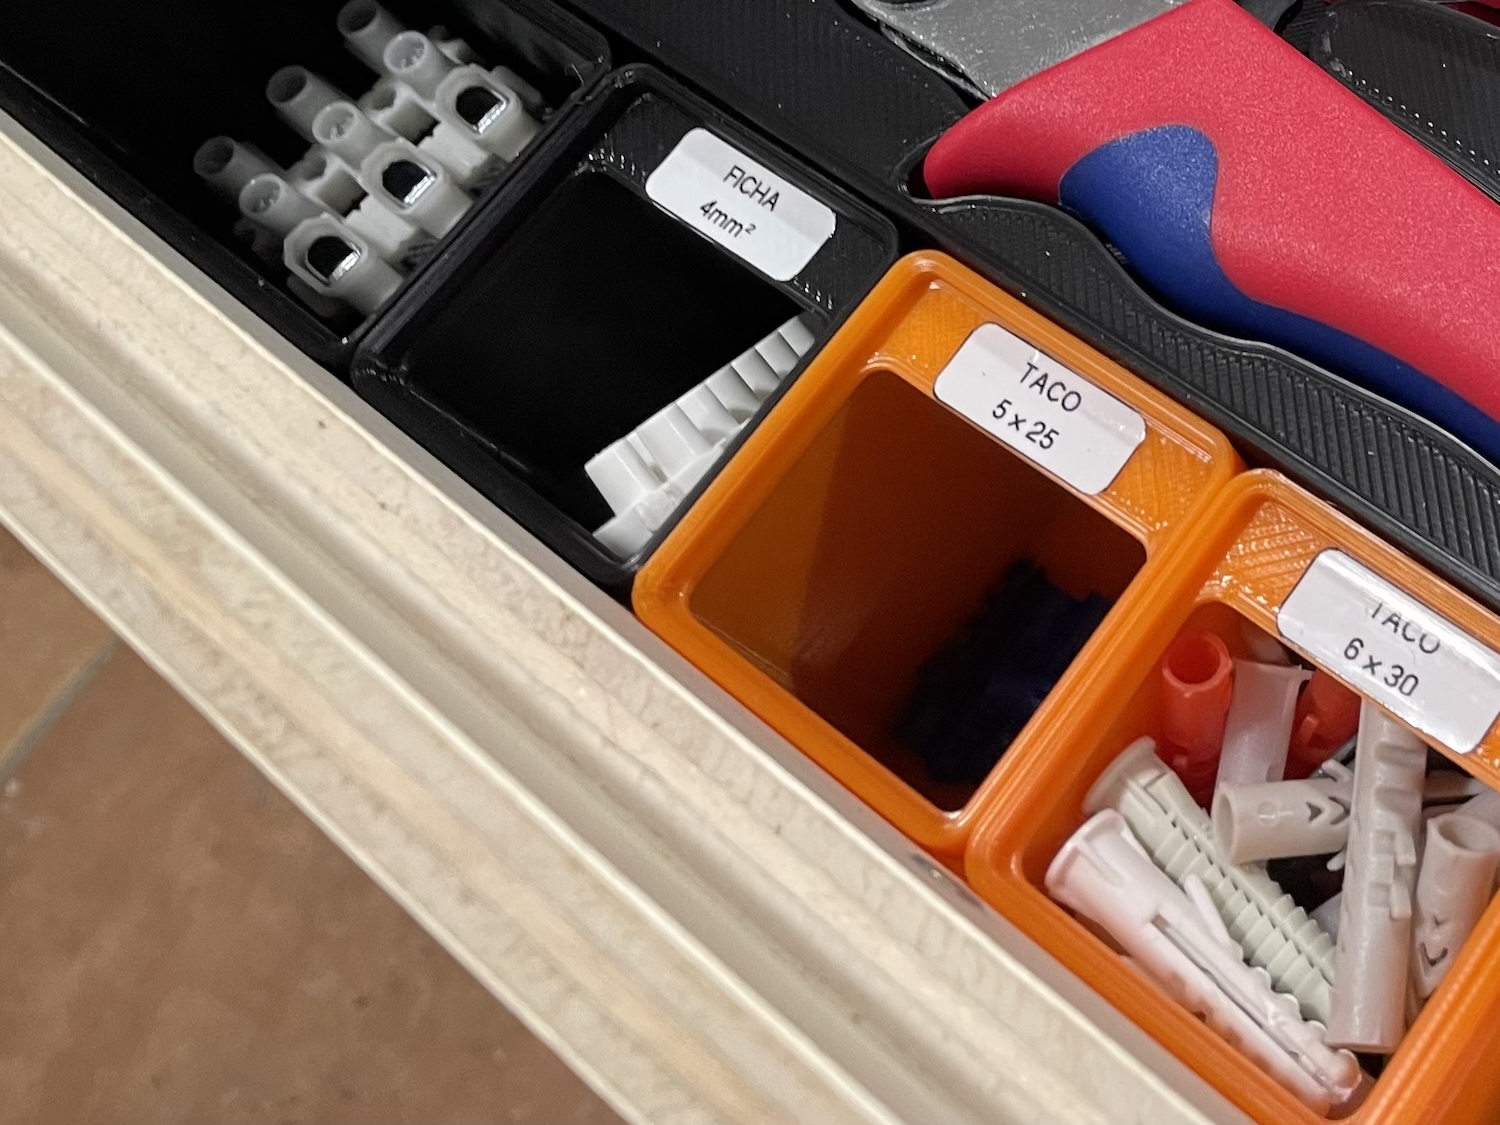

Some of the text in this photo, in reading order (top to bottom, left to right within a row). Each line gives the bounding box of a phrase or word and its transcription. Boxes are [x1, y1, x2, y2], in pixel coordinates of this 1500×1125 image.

[722, 164, 781, 213] FICHA
[699, 199, 757, 238] 4mm²
[1018, 361, 1083, 413] TACO
[992, 398, 1013, 420] 5
[1024, 420, 1061, 451] 25
[1343, 637, 1364, 661] 6
[1384, 665, 1419, 697] 30
